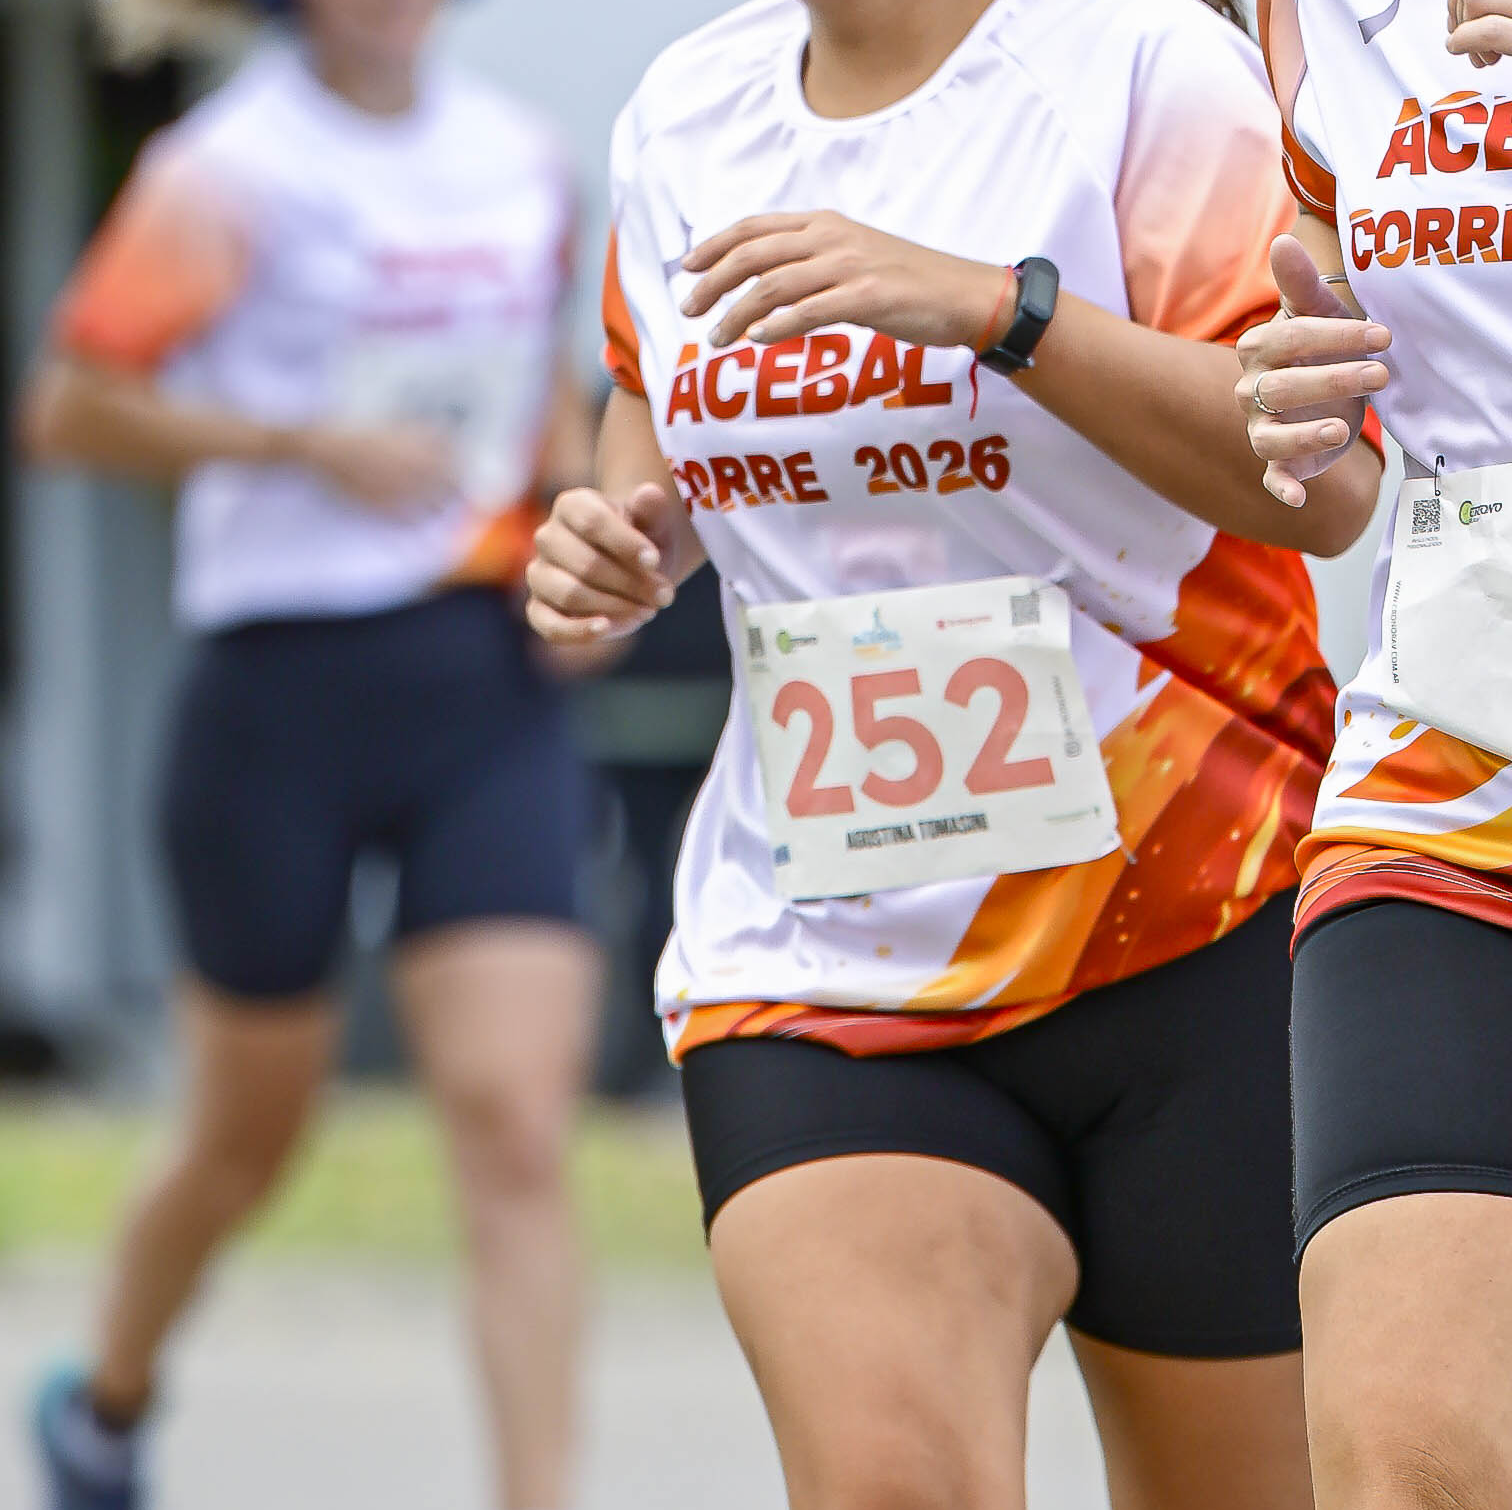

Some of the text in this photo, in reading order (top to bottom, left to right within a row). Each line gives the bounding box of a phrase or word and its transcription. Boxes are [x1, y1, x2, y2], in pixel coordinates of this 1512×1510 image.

[666, 332, 953, 427] ACEBAL
[855, 434, 1011, 495] 2026
[771, 657, 1056, 819] 252
